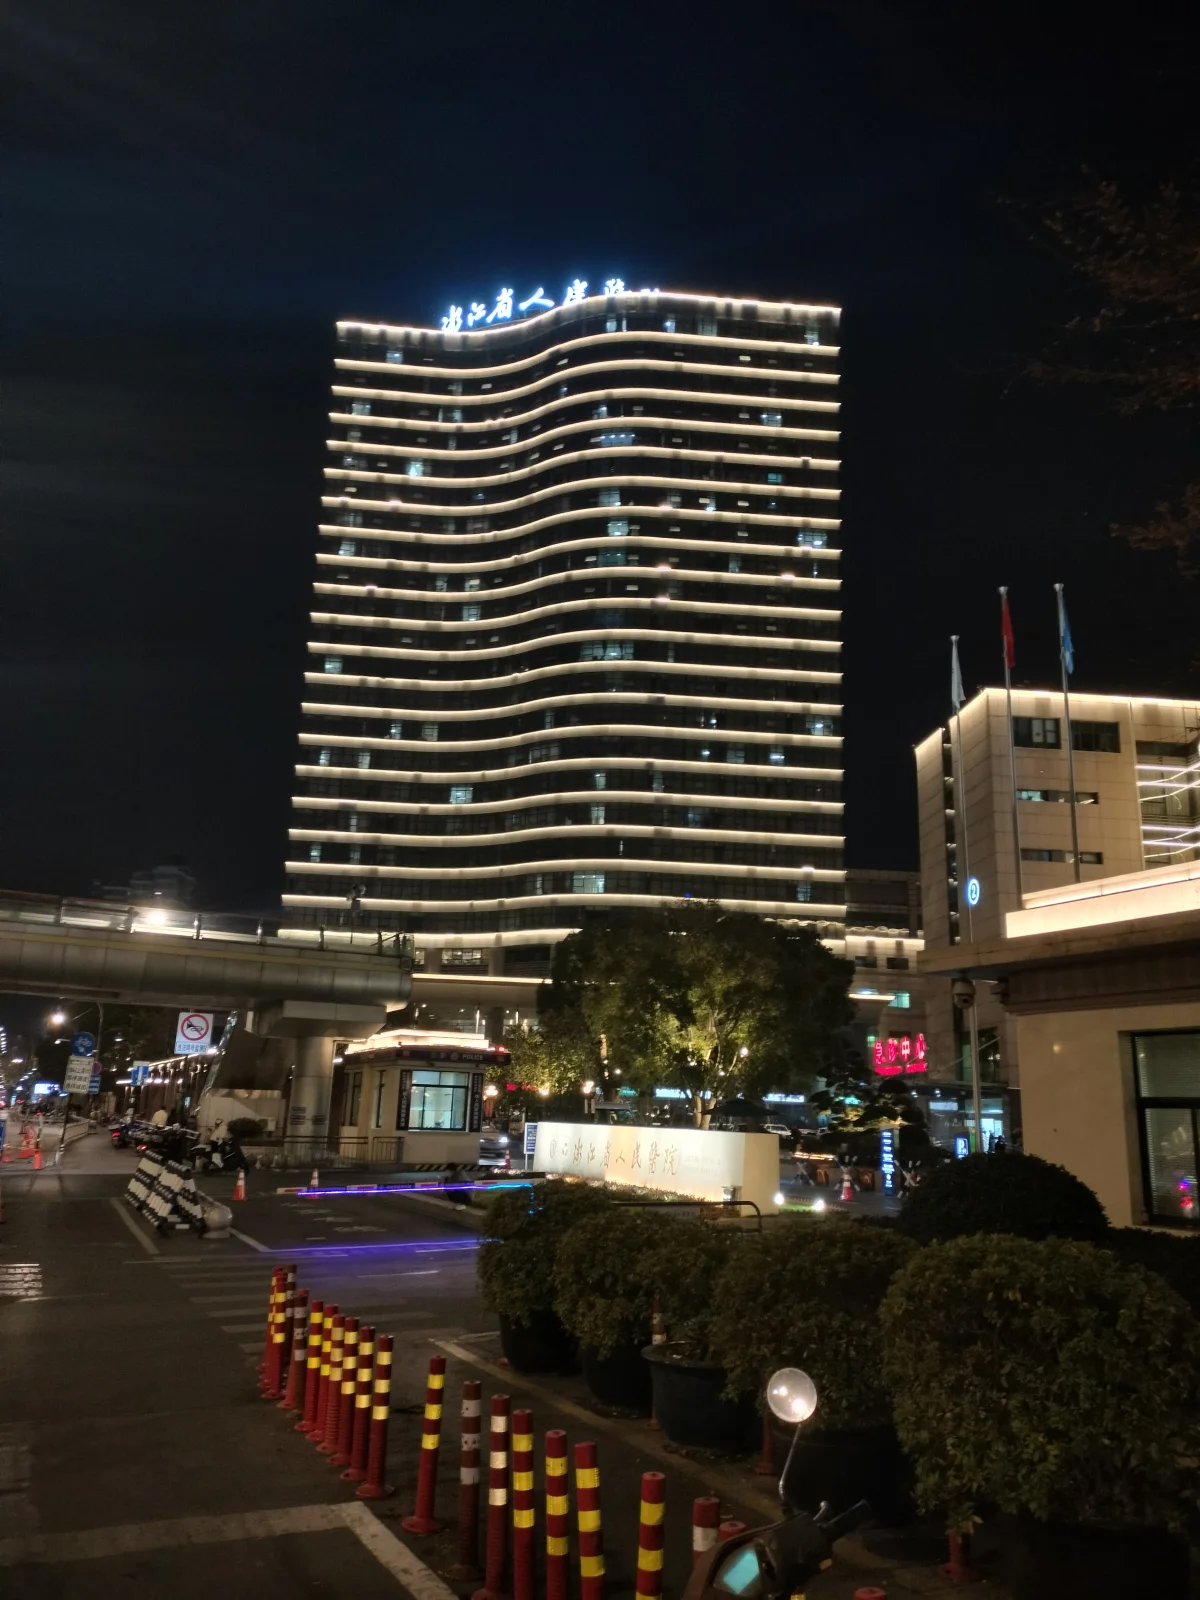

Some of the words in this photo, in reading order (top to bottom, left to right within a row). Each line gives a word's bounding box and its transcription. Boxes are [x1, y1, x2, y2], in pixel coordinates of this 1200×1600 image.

[440, 278, 660, 333] 浙江省人民
[462, 1053, 484, 1061] POLICE
